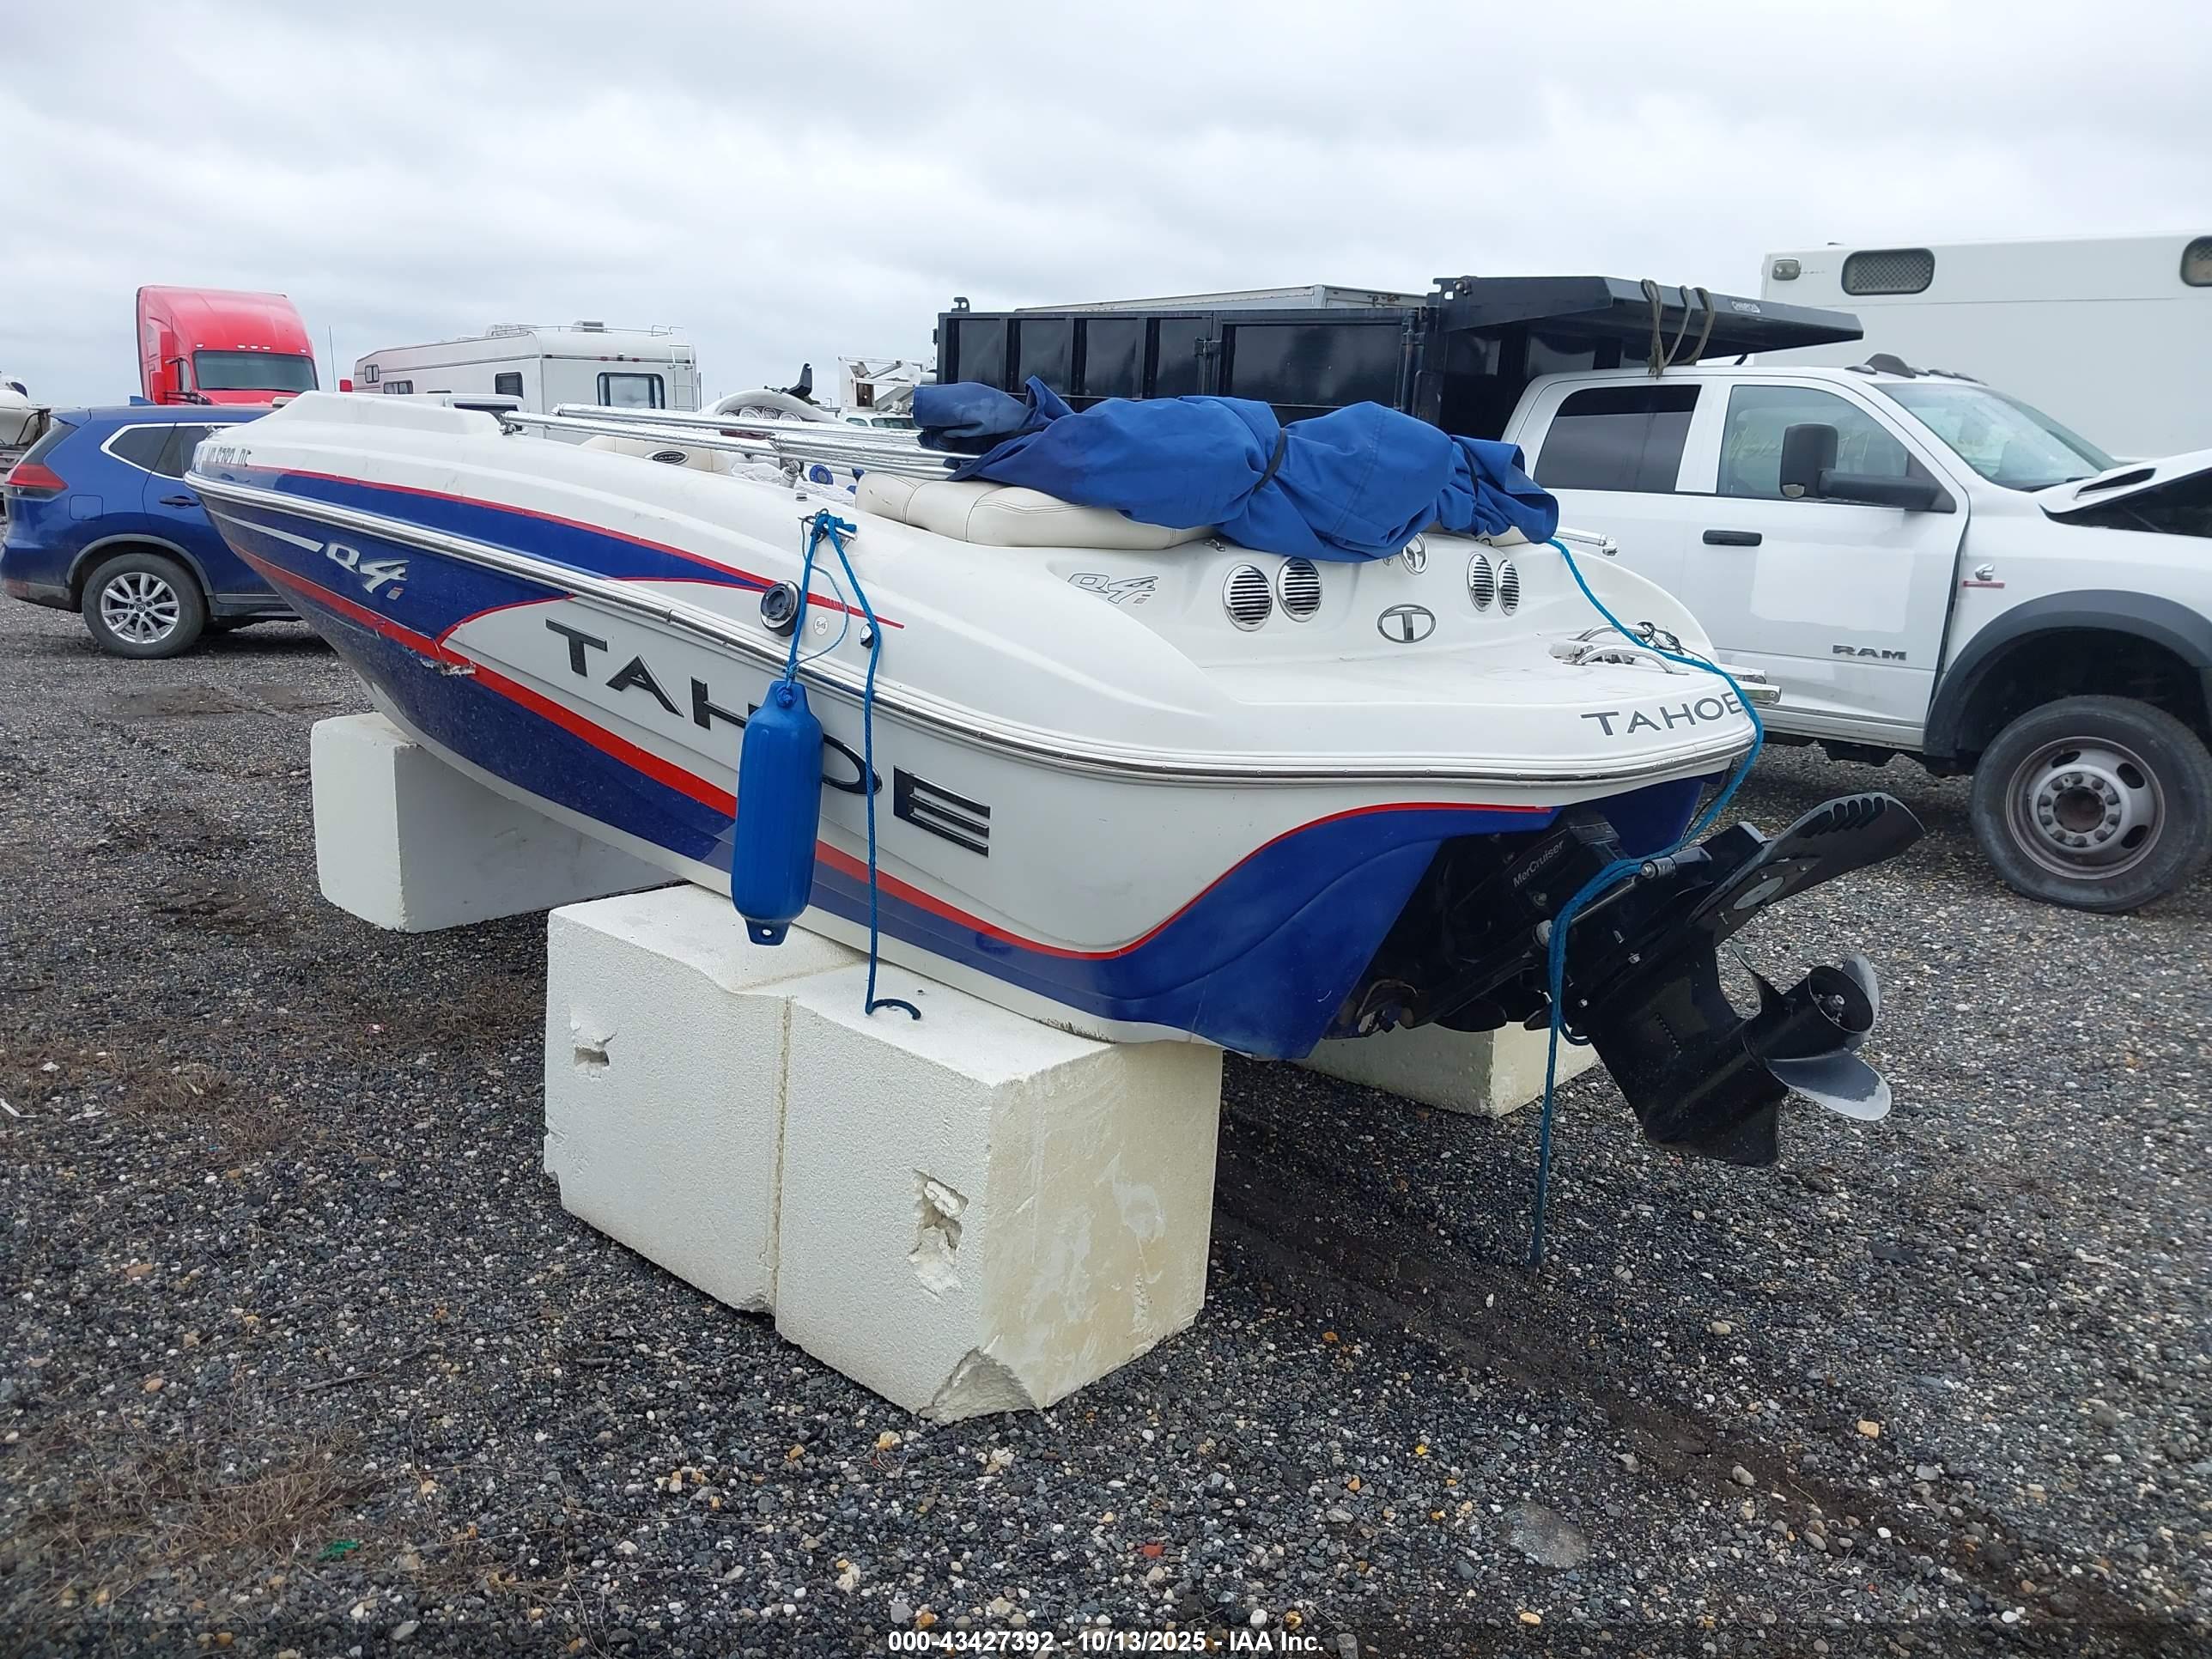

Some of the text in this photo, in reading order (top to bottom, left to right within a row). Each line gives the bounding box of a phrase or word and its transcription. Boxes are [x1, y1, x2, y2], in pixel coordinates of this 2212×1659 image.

[1832, 645, 1906, 661] RAM
[1580, 691, 1743, 736] TAHOE
[1512, 839, 1565, 888] MerCruiser
